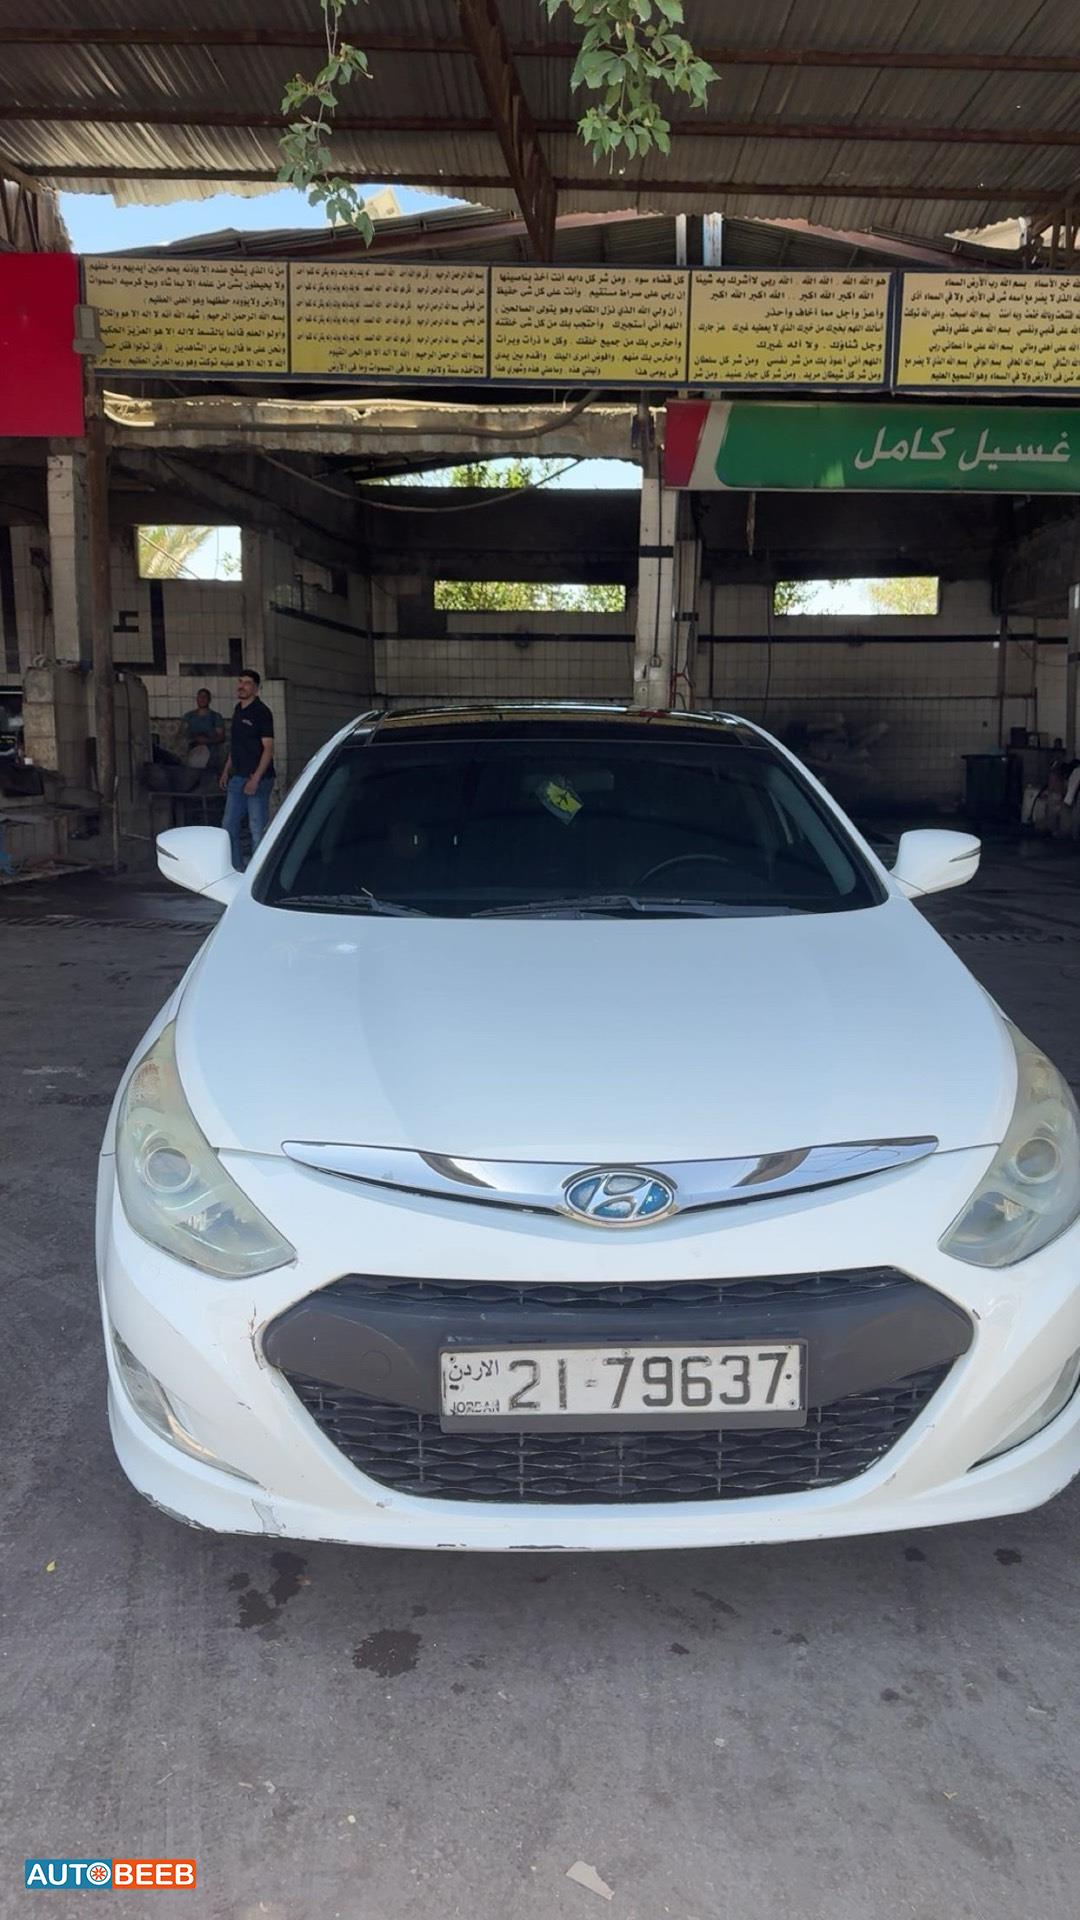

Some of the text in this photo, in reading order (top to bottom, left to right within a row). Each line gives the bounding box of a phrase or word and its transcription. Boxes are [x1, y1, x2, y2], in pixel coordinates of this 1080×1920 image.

[853, 425, 1071, 473] غسيل كامل
[508, 1352, 789, 1411] 21 79637
